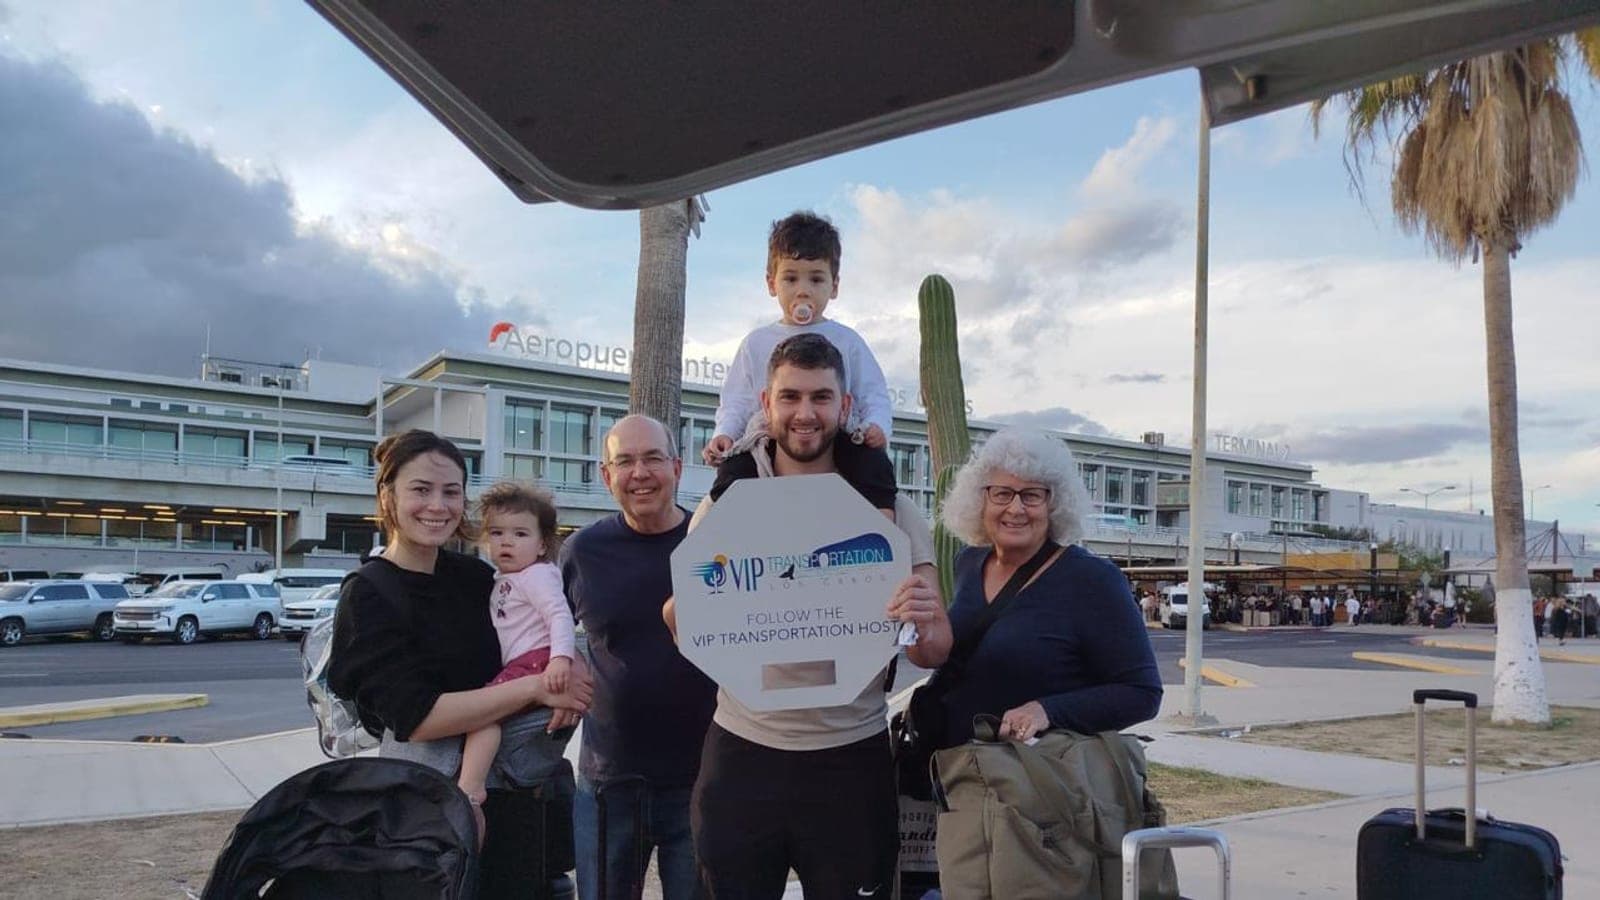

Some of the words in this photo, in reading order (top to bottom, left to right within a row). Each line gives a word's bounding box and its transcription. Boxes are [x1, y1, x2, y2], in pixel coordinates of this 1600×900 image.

[1215, 433, 1278, 457] TERMINAL
[729, 557, 764, 592] VIP
[766, 548, 886, 570] TRANSPORTATION
[746, 609, 811, 626] FOLLOW
[815, 606, 846, 621] THE
[692, 633, 716, 648] VIP
[720, 623, 854, 646] TRANSPORTATION
[858, 619, 900, 634] HOST
